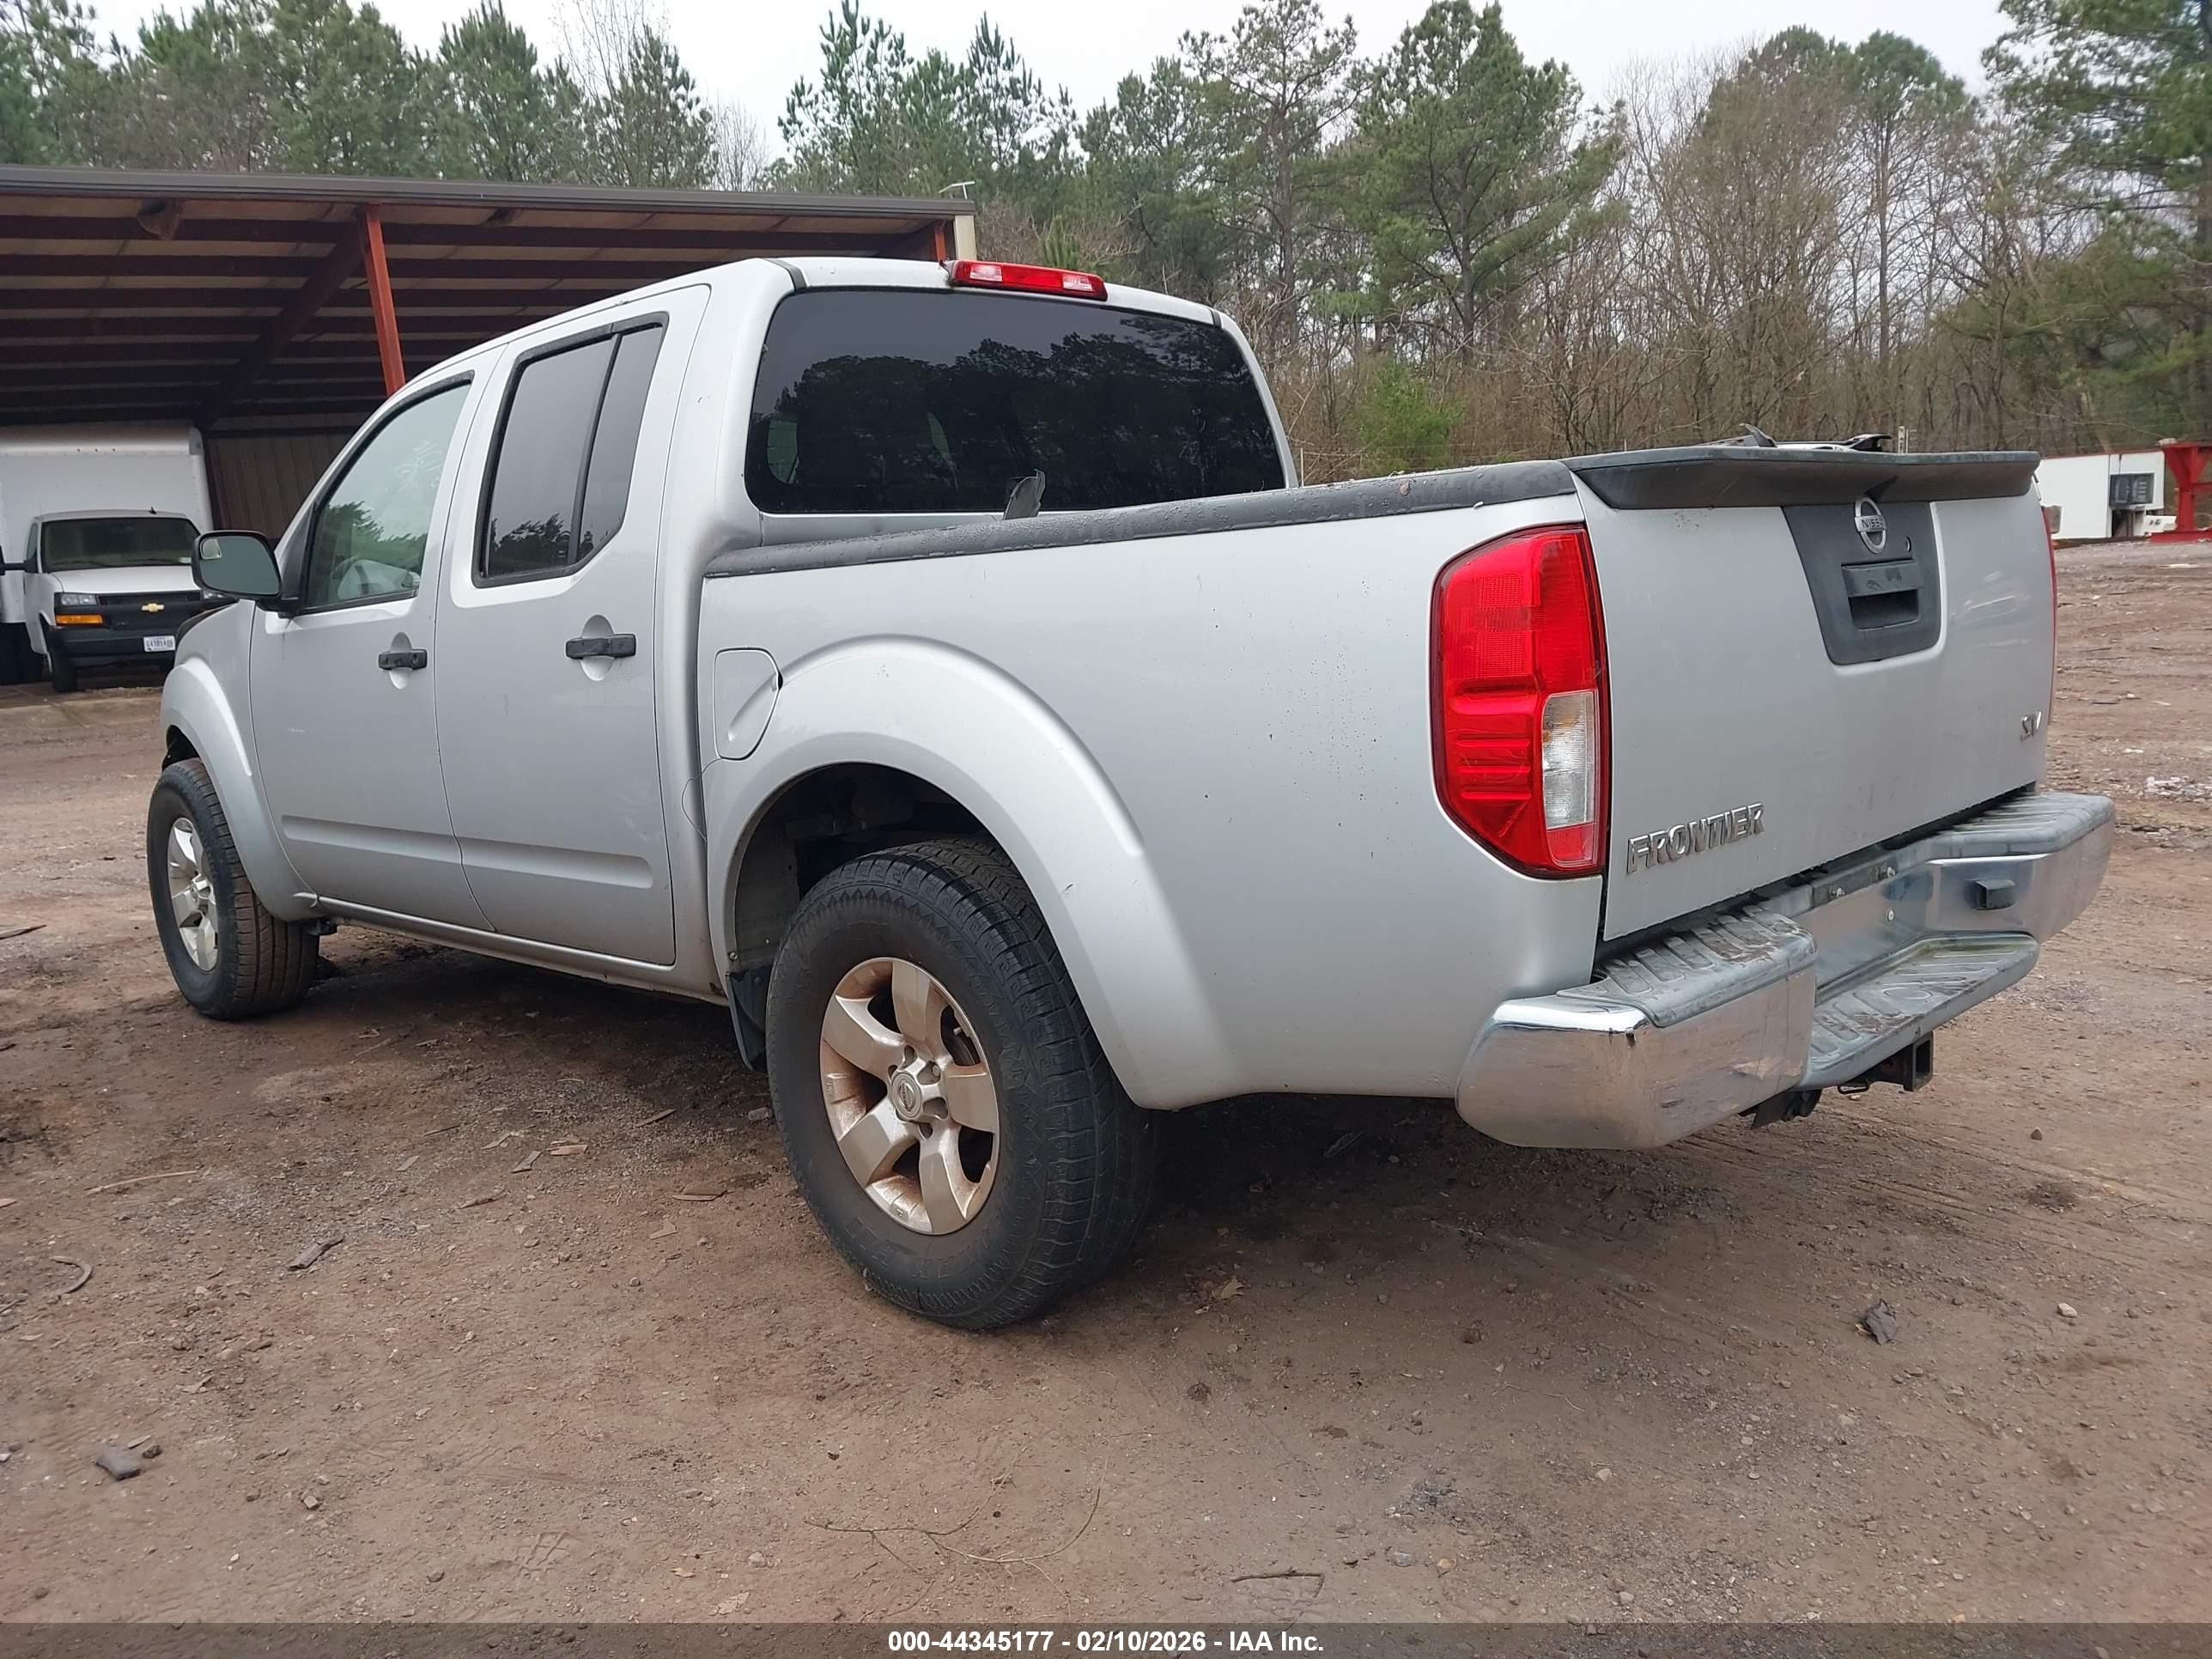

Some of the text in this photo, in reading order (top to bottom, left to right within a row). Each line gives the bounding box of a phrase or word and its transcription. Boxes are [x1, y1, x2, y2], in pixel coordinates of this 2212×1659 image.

[1861, 518, 1884, 529] NISS
[2021, 711, 2042, 742] SV
[1626, 802, 1765, 874] FRONTIER
